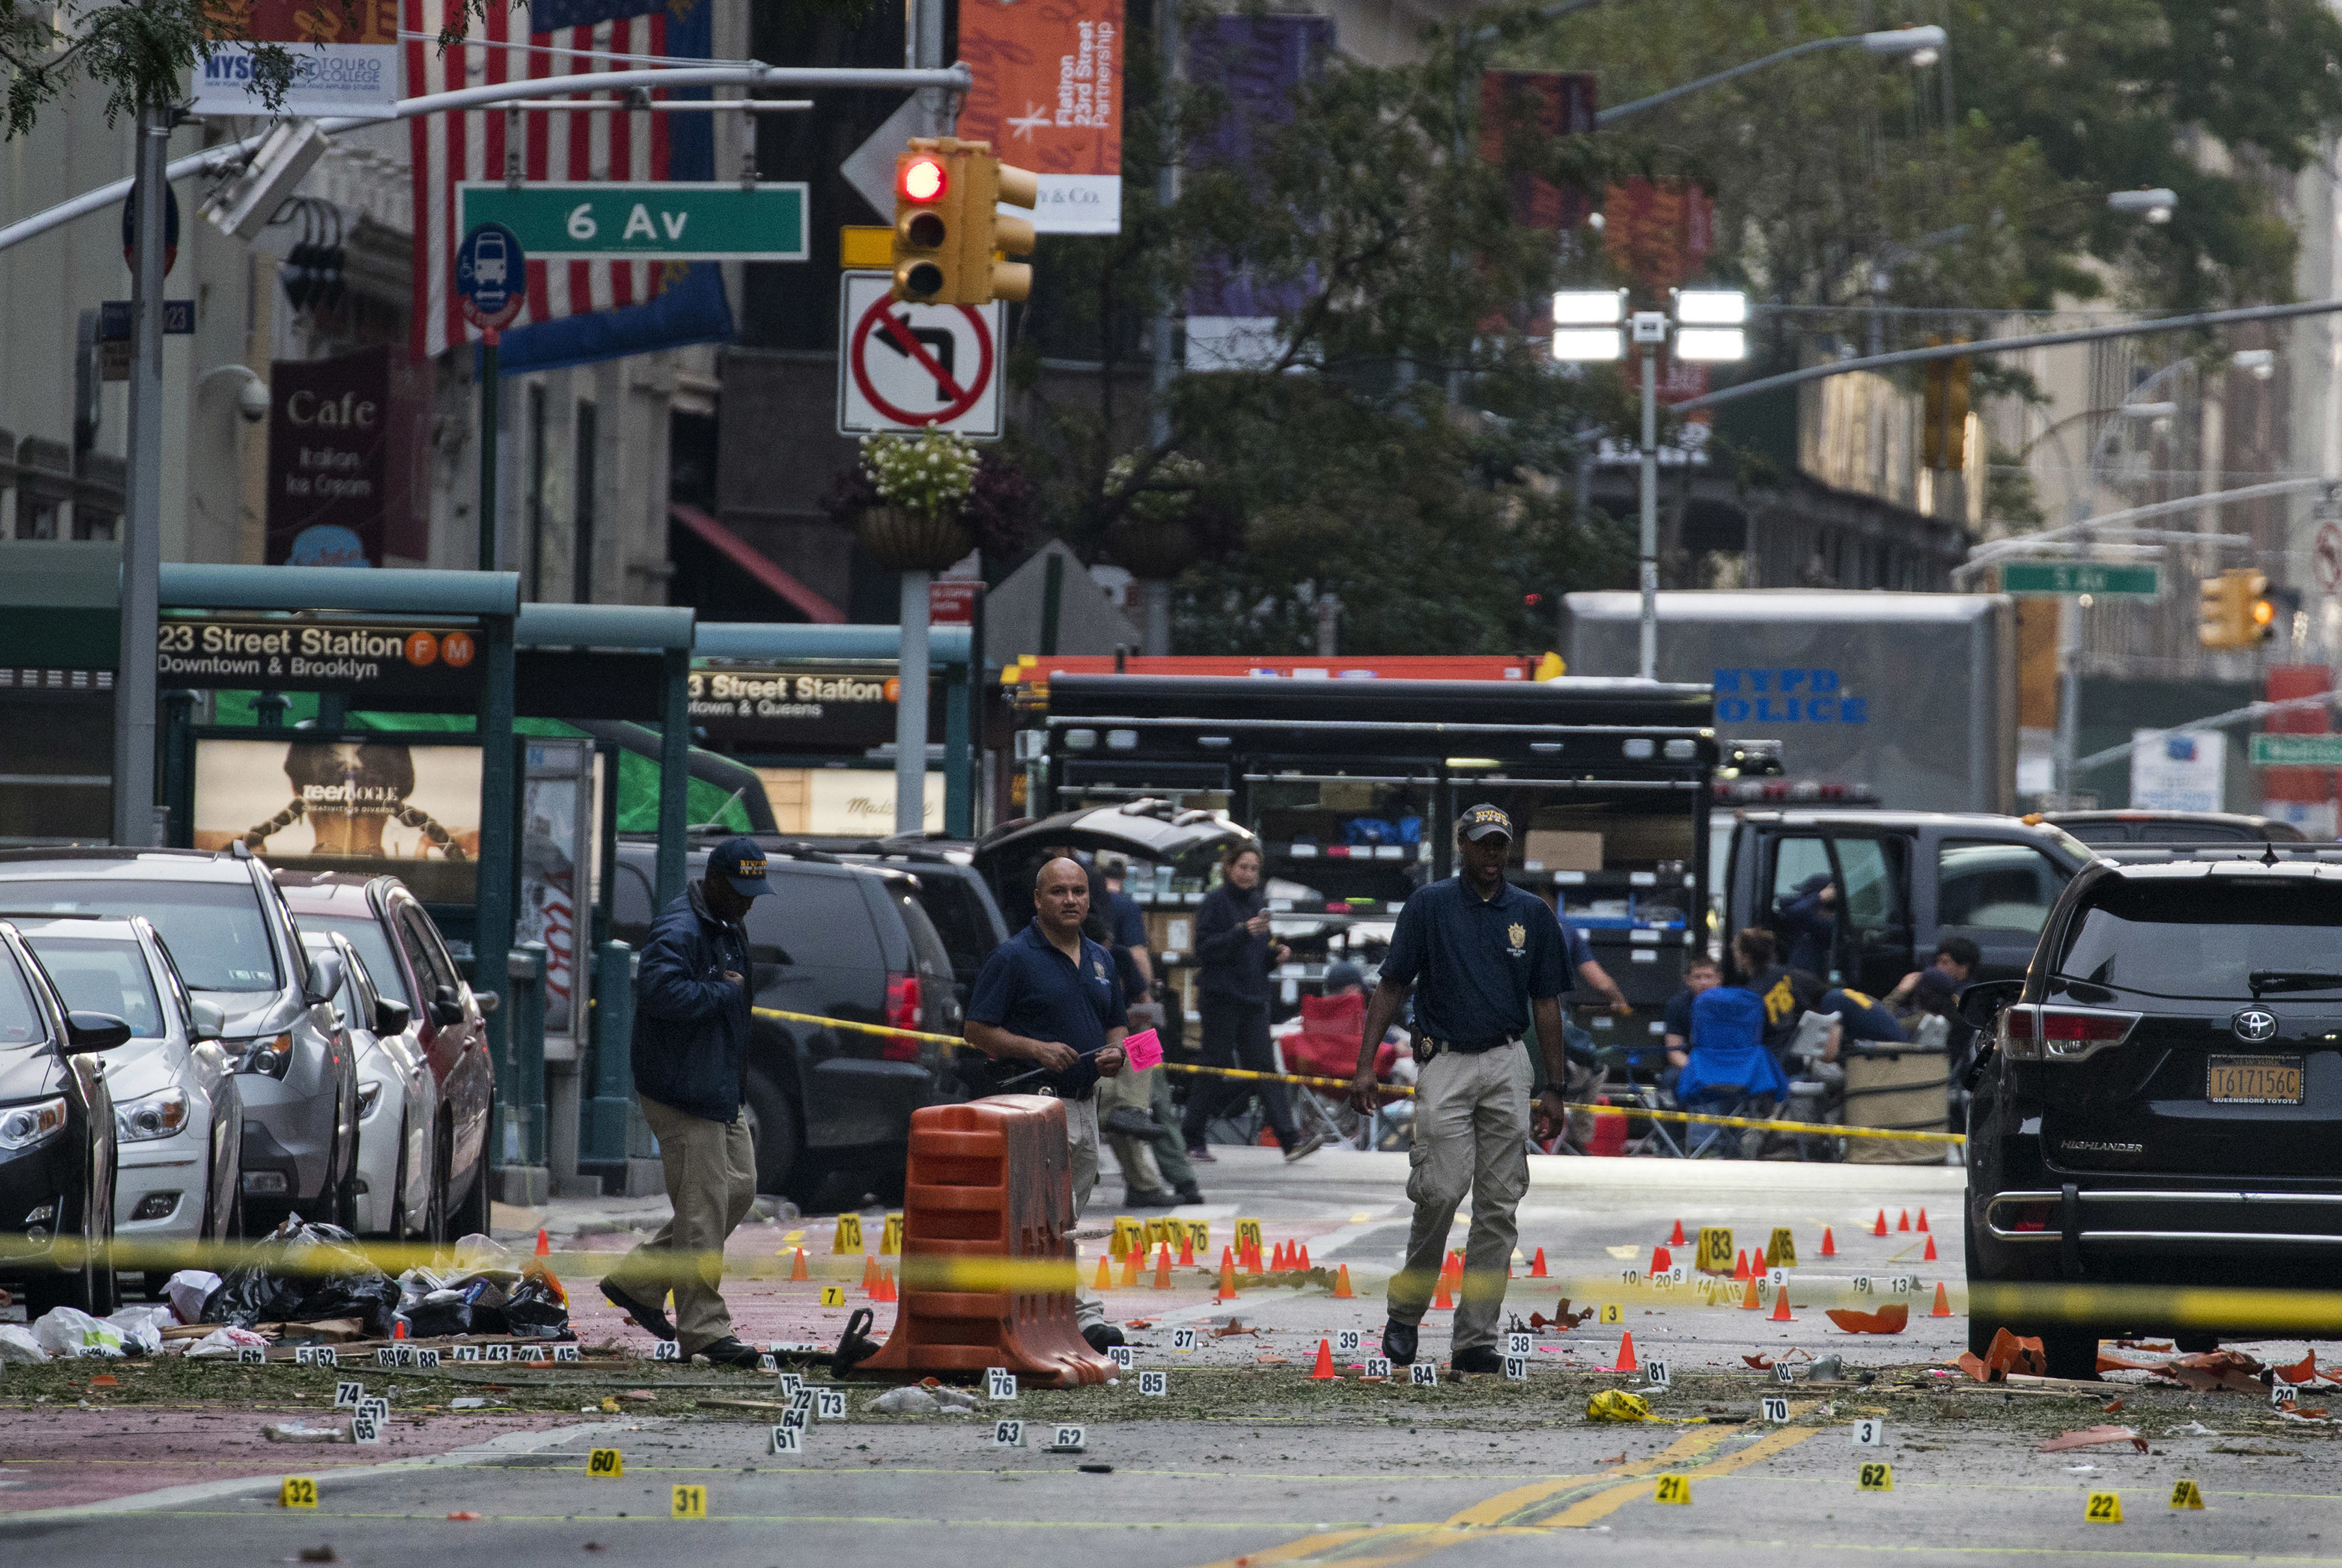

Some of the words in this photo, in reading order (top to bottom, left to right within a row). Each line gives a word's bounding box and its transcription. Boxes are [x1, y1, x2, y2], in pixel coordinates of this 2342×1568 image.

[1076, 21, 1094, 79] Street
[323, 58, 381, 71] TOURO
[323, 70, 380, 82] COLLEGE
[1093, 21, 1115, 128] Partnership
[1055, 55, 1073, 126] Flatiron
[1075, 83, 1093, 127] 23rd
[567, 203, 597, 240] 6
[623, 203, 688, 240] Av
[288, 390, 375, 427] Cafe
[158, 625, 194, 651] 23
[202, 625, 291, 653] Street
[301, 629, 402, 657] Station
[448, 640, 467, 658] M
[157, 655, 260, 674] Downtown
[267, 656, 282, 675] &
[291, 657, 378, 681] Brooklyn
[687, 674, 704, 697] 3
[712, 675, 788, 700] Street
[796, 676, 883, 702] Station
[1714, 668, 1840, 692] NYPD
[738, 699, 752, 716] &
[757, 699, 824, 717] Queens
[1717, 697, 1868, 723] OLICE
[2216, 1068, 2295, 1094] T617156C
[2060, 1140, 2143, 1152] HIGHLANDER
[1711, 1230, 1732, 1260] 83
[1622, 1270, 1637, 1284] 10
[1655, 1275, 1672, 1289] 20
[1774, 1271, 1782, 1284] 9
[1853, 1277, 1867, 1291] 19
[1892, 1278, 1907, 1293] 13
[828, 1288, 836, 1304] 7
[1609, 1305, 1617, 1321] 3
[1174, 1330, 1193, 1347] 37
[1339, 1331, 1358, 1349] 39
[1511, 1335, 1529, 1353] 38
[318, 1349, 335, 1366] 52
[380, 1349, 396, 1366] 89
[419, 1351, 437, 1367] 88
[655, 1342, 676, 1359] 42
[1367, 1359, 1388, 1376] 83
[1413, 1365, 1434, 1385] 84
[1507, 1358, 1524, 1377] 97
[1650, 1362, 1665, 1381] 81
[1777, 1362, 1792, 1381] 82
[782, 1375, 801, 1394] 75
[992, 1377, 1013, 1396] 76
[1142, 1373, 1163, 1392] 85
[338, 1384, 358, 1404] 74
[792, 1390, 812, 1409] 72
[820, 1394, 842, 1414] 73
[1766, 1400, 1786, 1420] 70
[355, 1418, 375, 1439] 65
[783, 1409, 805, 1429] 64
[775, 1427, 795, 1448] 61
[996, 1422, 1019, 1442] 63
[1058, 1429, 1081, 1444] 62
[1862, 1423, 1872, 1442] 3
[591, 1450, 615, 1472] 60
[1861, 1465, 1885, 1486] 62
[288, 1480, 314, 1502] 32
[1658, 1478, 1679, 1498] 21
[676, 1489, 699, 1512] 31
[2089, 1495, 2114, 1517] 22
